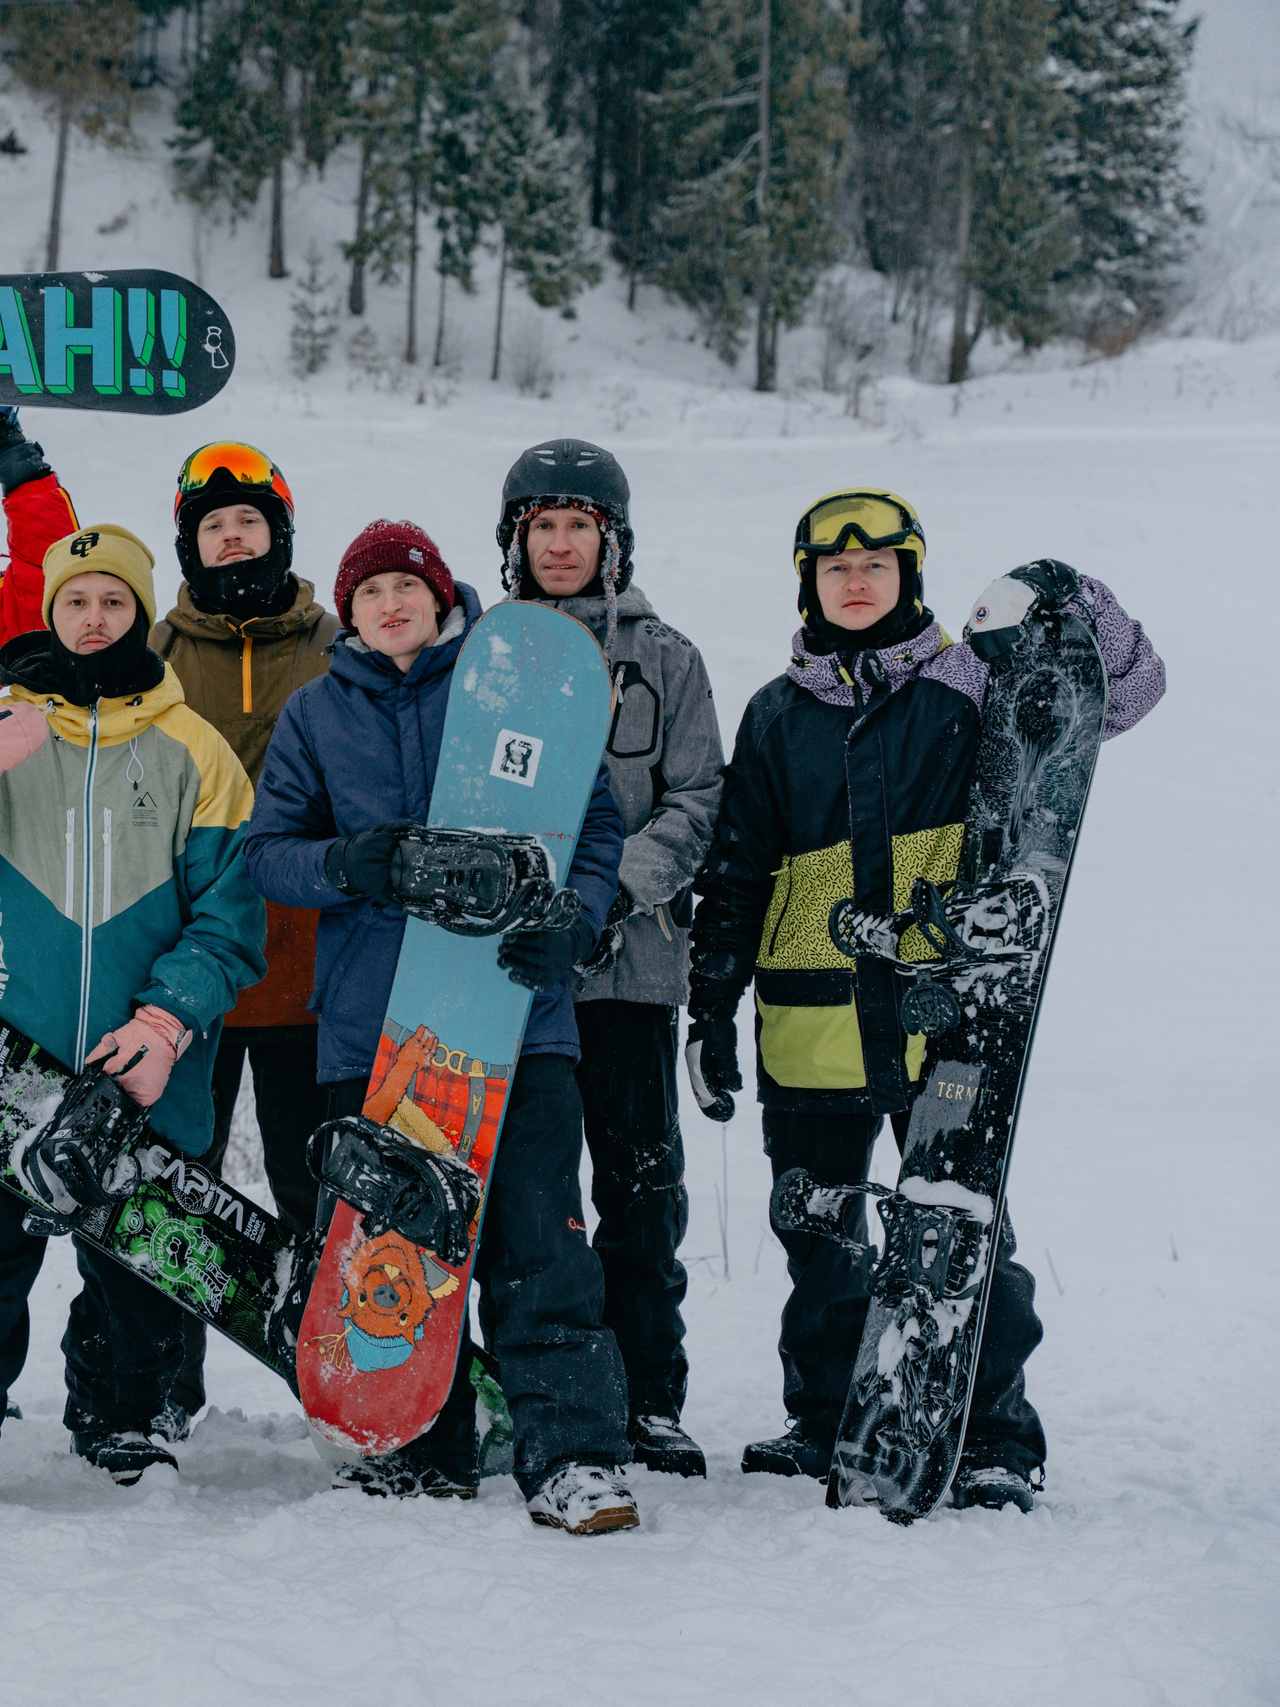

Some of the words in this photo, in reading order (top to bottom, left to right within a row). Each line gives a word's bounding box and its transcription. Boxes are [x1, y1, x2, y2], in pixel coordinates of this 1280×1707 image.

[937, 1081, 995, 1105] TERMIT
[243, 1212, 258, 1237] SUPER
[249, 1220, 262, 1241] CORP.
